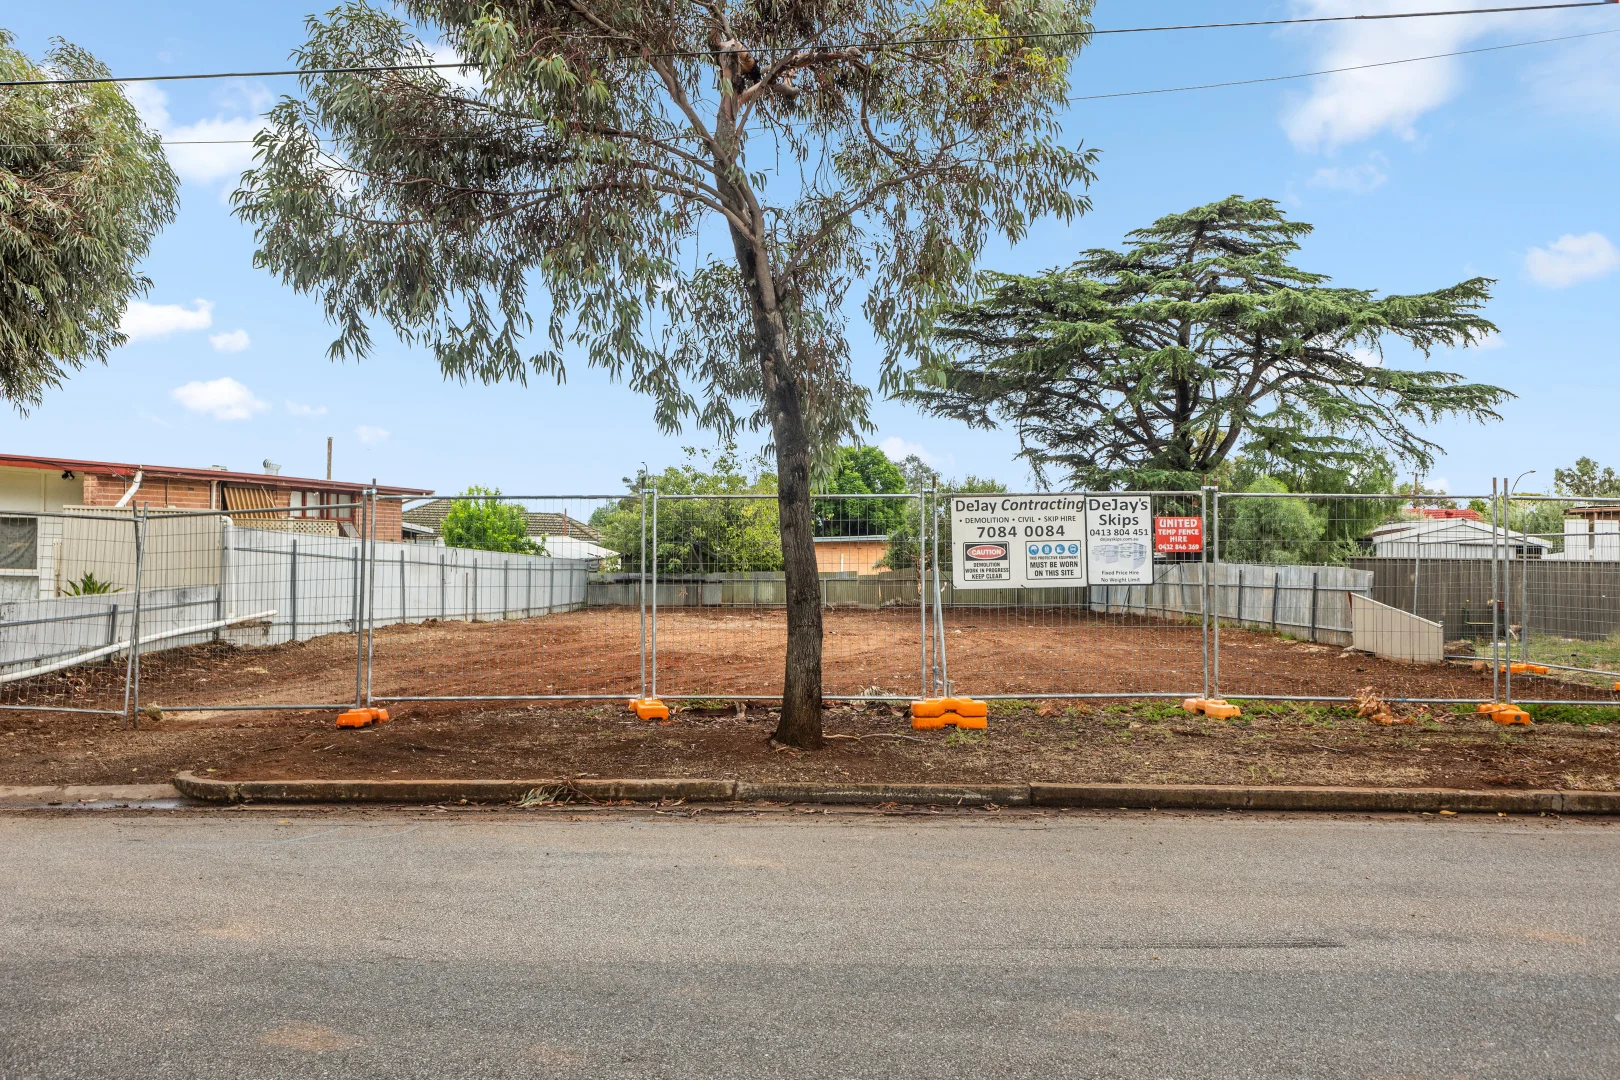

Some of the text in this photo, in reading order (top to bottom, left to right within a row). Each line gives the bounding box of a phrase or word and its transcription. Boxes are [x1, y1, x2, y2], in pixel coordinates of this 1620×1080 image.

[956, 498, 1084, 514] DeJay Contracting
[1089, 498, 1148, 513] DeJay's
[1099, 514, 1139, 528] Skips
[1159, 519, 1197, 528] UNITED
[977, 525, 1065, 538] 7084 0084
